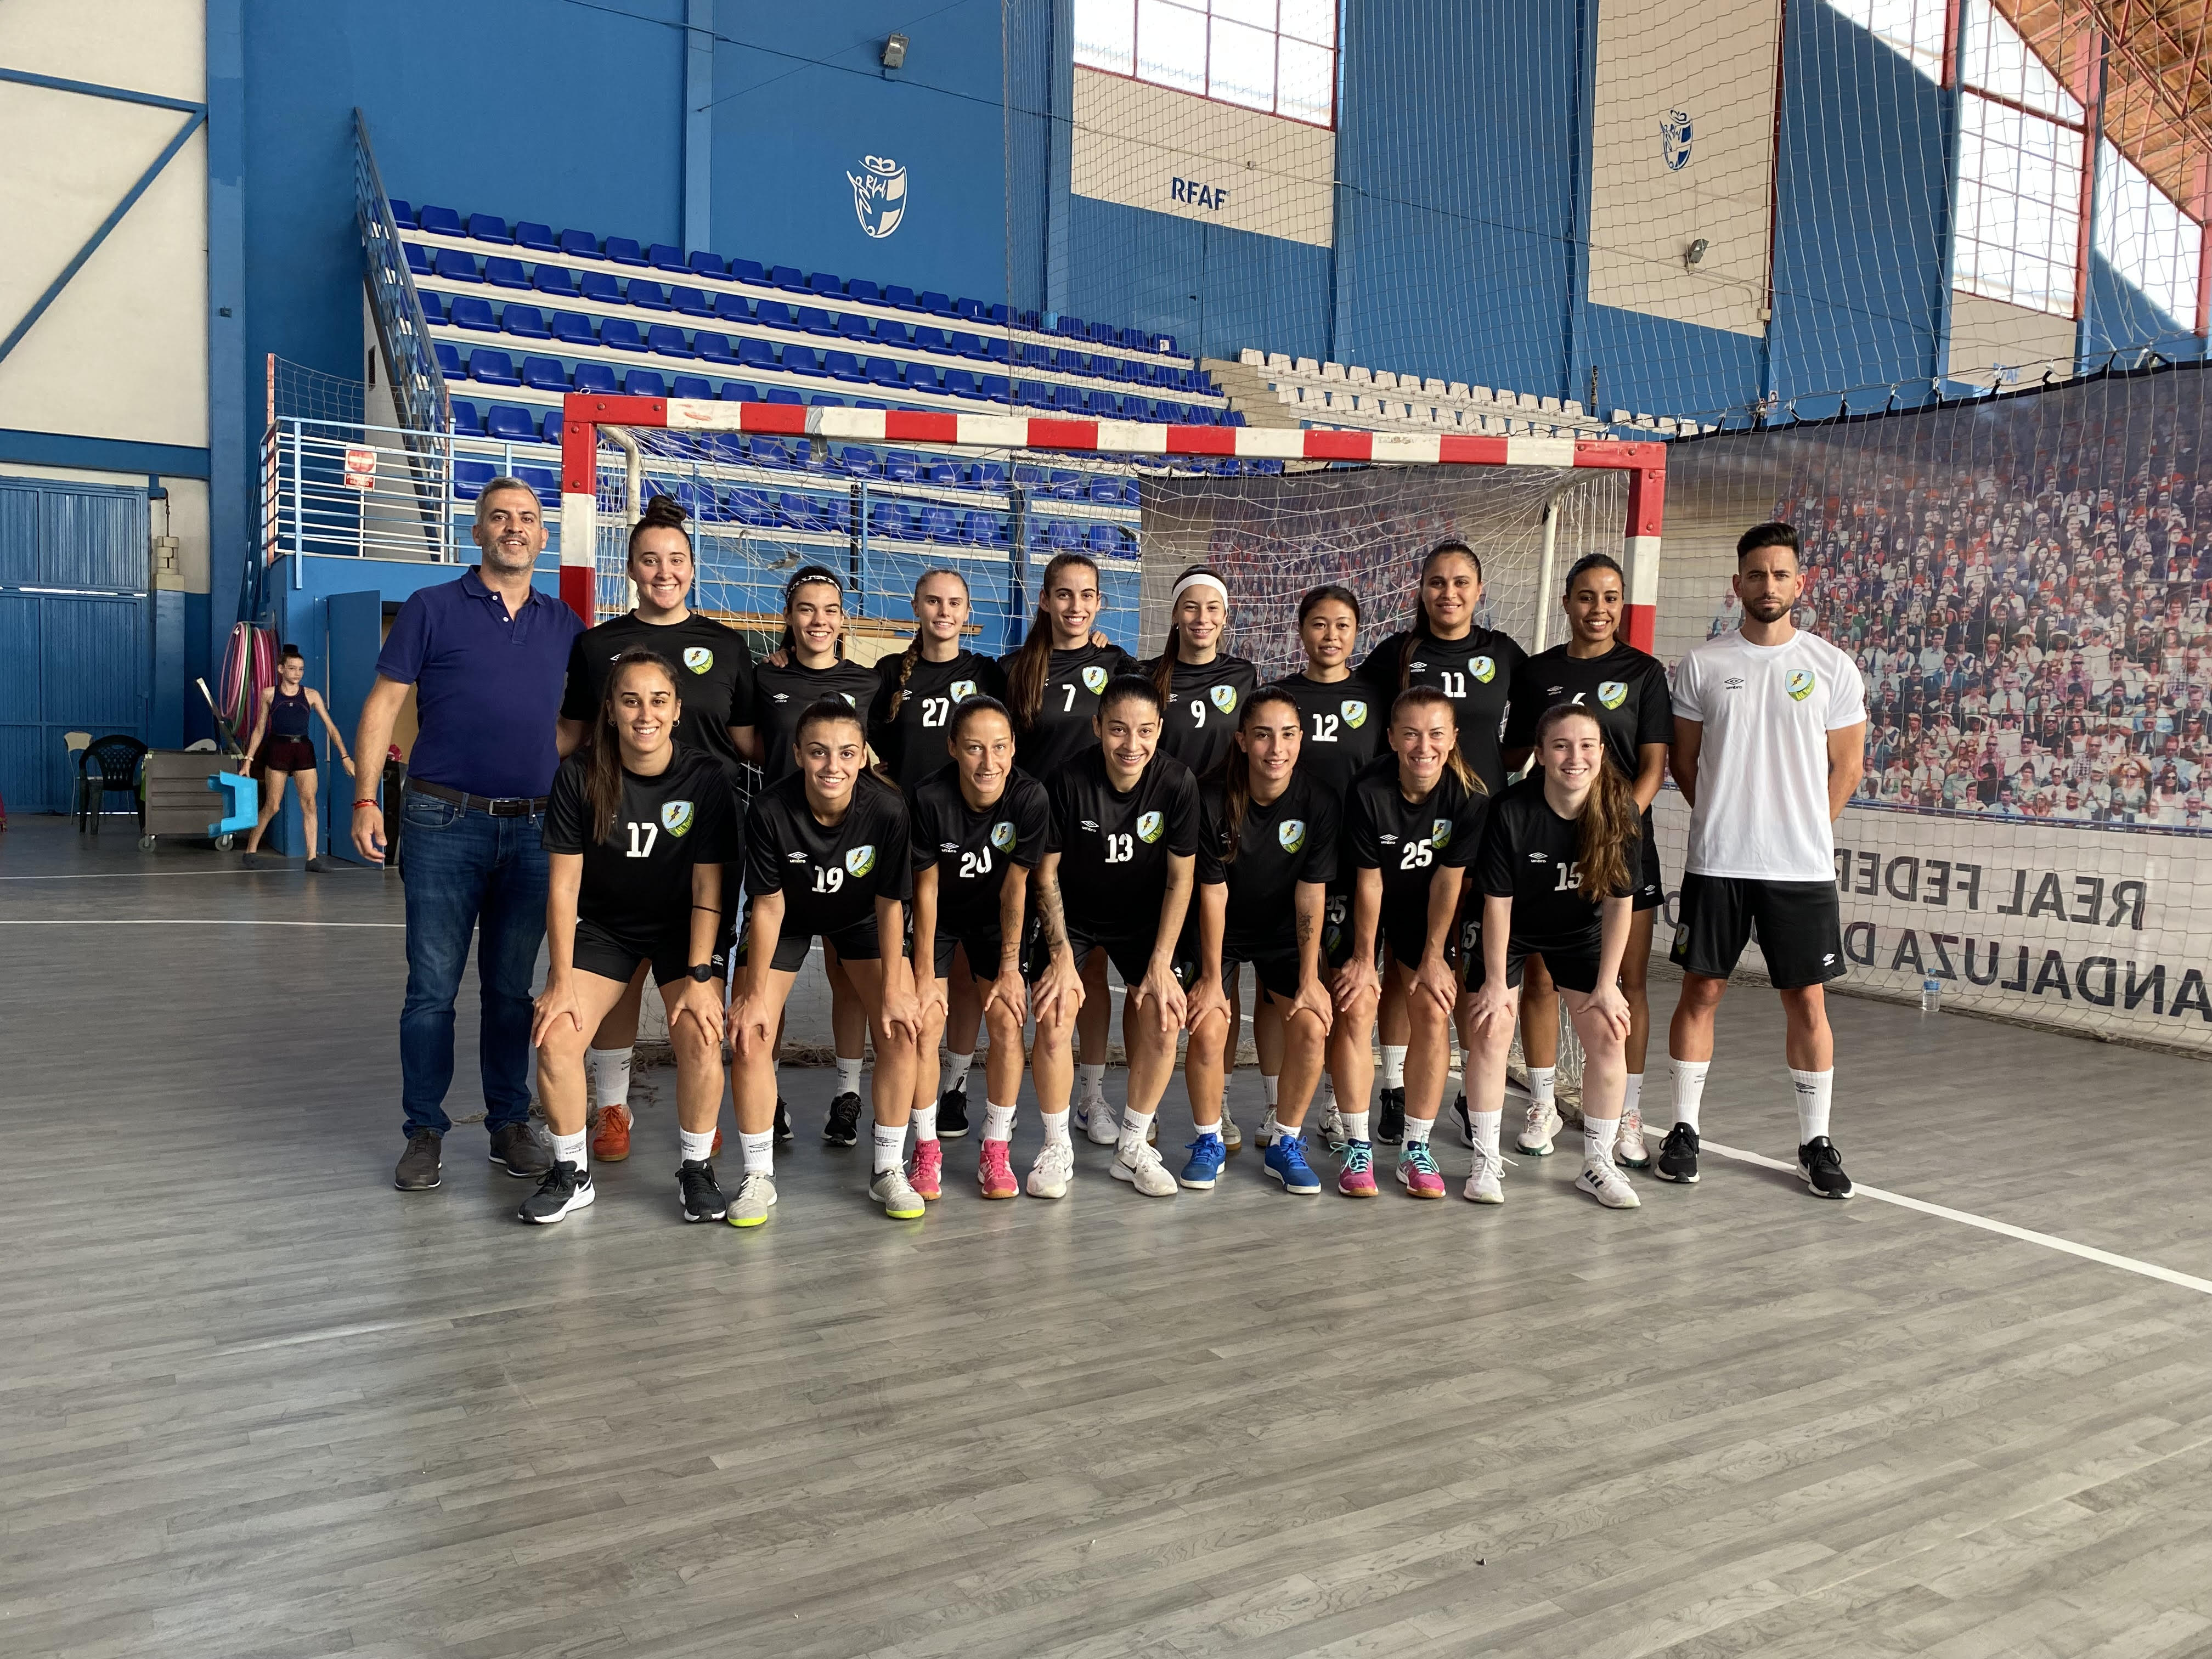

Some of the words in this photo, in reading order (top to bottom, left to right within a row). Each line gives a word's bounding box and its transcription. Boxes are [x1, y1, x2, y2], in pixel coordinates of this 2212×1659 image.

[1172, 177, 1226, 211] RFAF
[1063, 684, 1076, 712] 7
[1441, 672, 1466, 698] 11
[922, 697, 950, 727] 27
[1190, 699, 1206, 729] 9
[1312, 713, 1339, 742] 12
[627, 822, 658, 857] 17
[1105, 833, 1133, 863] 13
[1399, 838, 1432, 870] 25
[960, 845, 992, 878] 20
[1554, 861, 1584, 891] 15
[812, 865, 844, 893] 19
